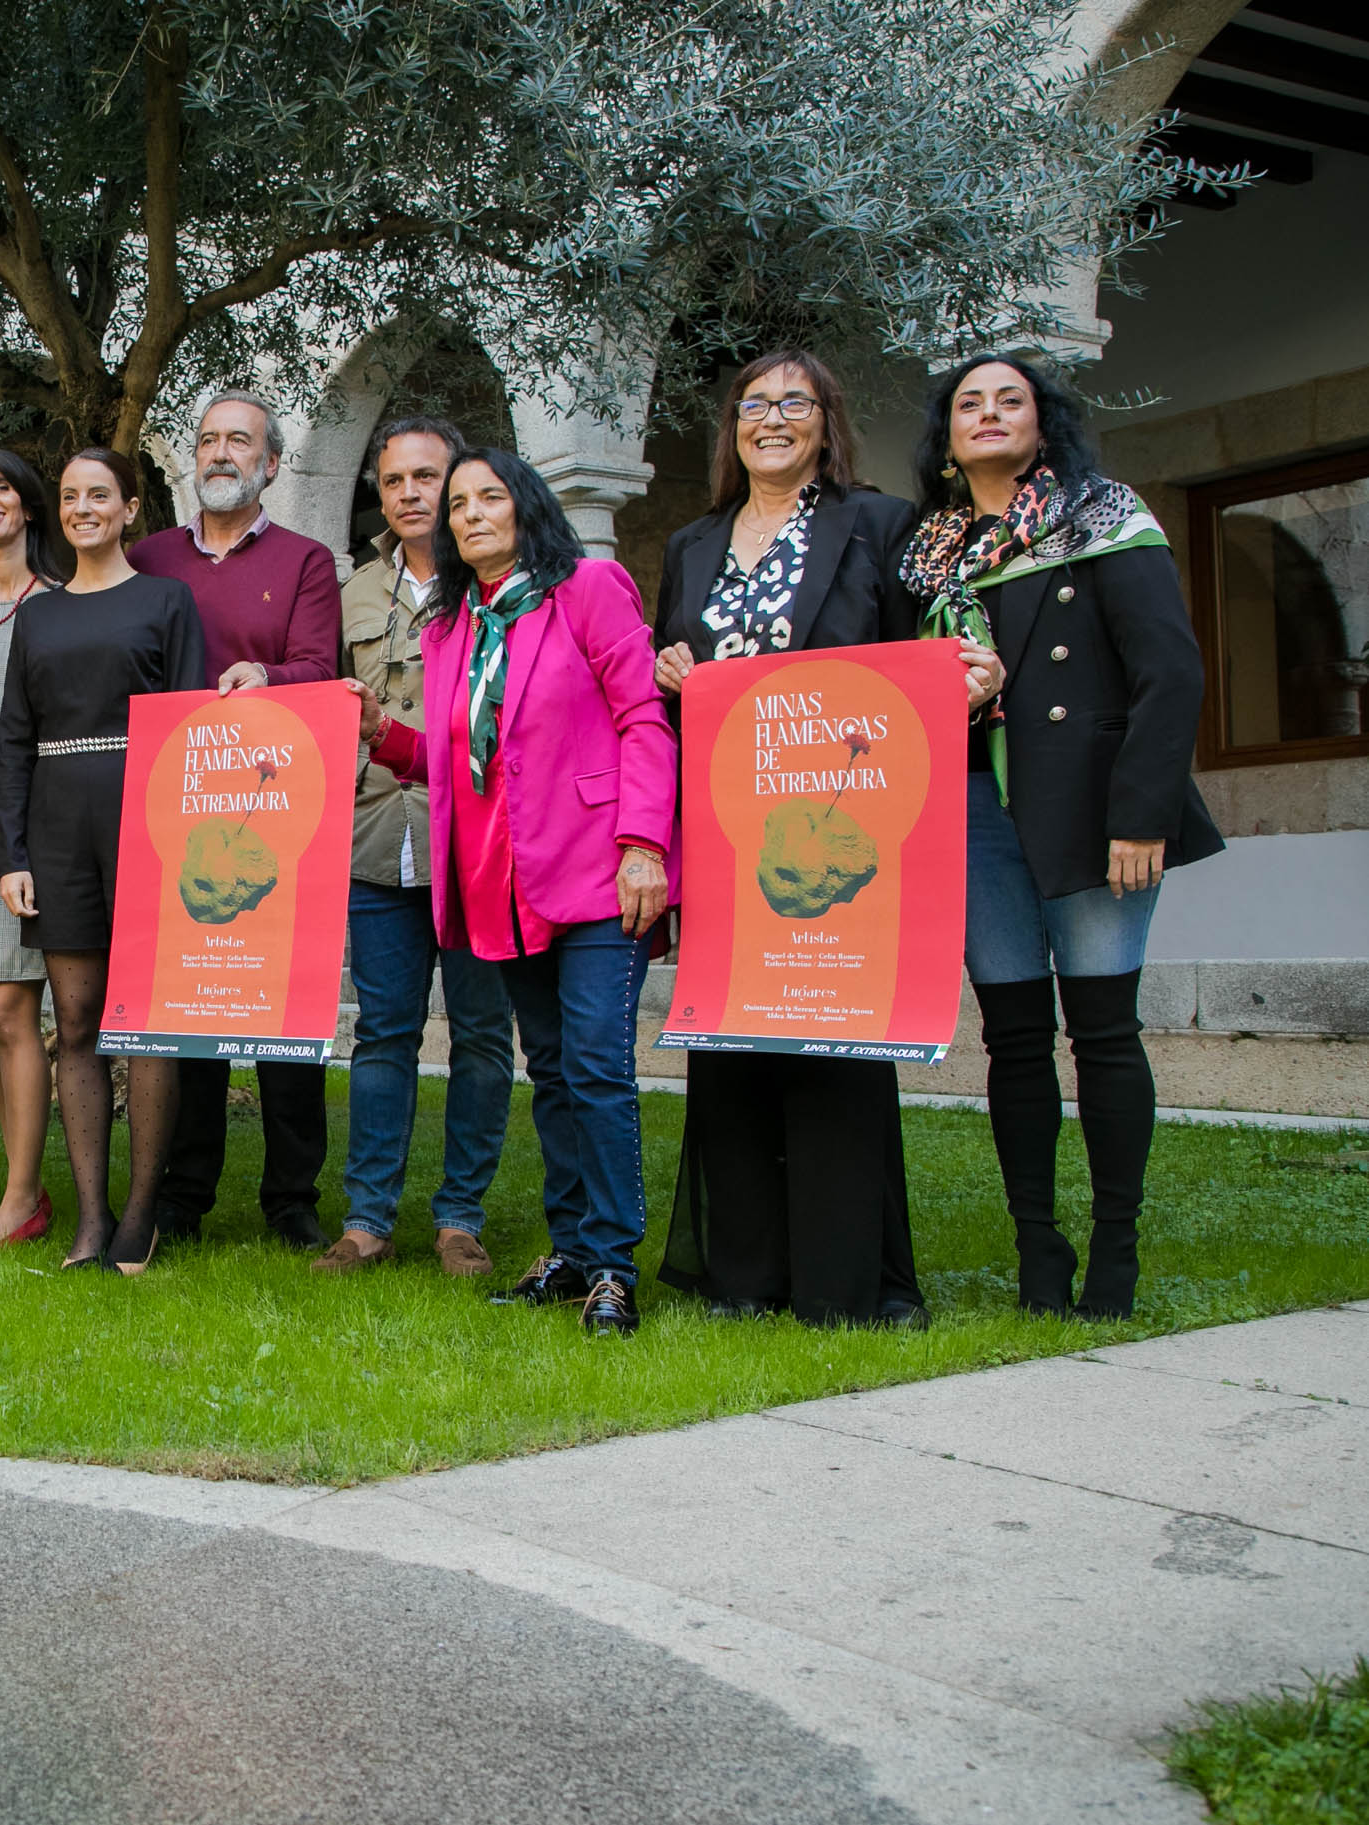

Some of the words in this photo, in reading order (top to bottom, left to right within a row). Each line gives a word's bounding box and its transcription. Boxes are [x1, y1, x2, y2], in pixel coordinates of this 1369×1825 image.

[755, 691, 823, 721] MINAS
[186, 723, 242, 748] MINAS
[755, 714, 888, 748] FLAMENCAS
[184, 744, 293, 772] FLAMENCAS
[755, 748, 781, 771] DE
[183, 772, 204, 792] DE
[755, 767, 887, 796] EXTREMADURA
[182, 791, 290, 814] EXTREMADURA
[205, 935, 246, 948] Artistas
[791, 930, 840, 944] Artistas
[197, 983, 241, 999] Lugares
[782, 983, 837, 1001] Lugares
[216, 1042, 240, 1055] JUNTA
[243, 1044, 256, 1055] DE
[256, 1044, 316, 1057] EXTREMADURA
[799, 1043, 830, 1053] JUNTA
[833, 1045, 850, 1054] DE
[851, 1046, 925, 1059] EXTREMADURA
